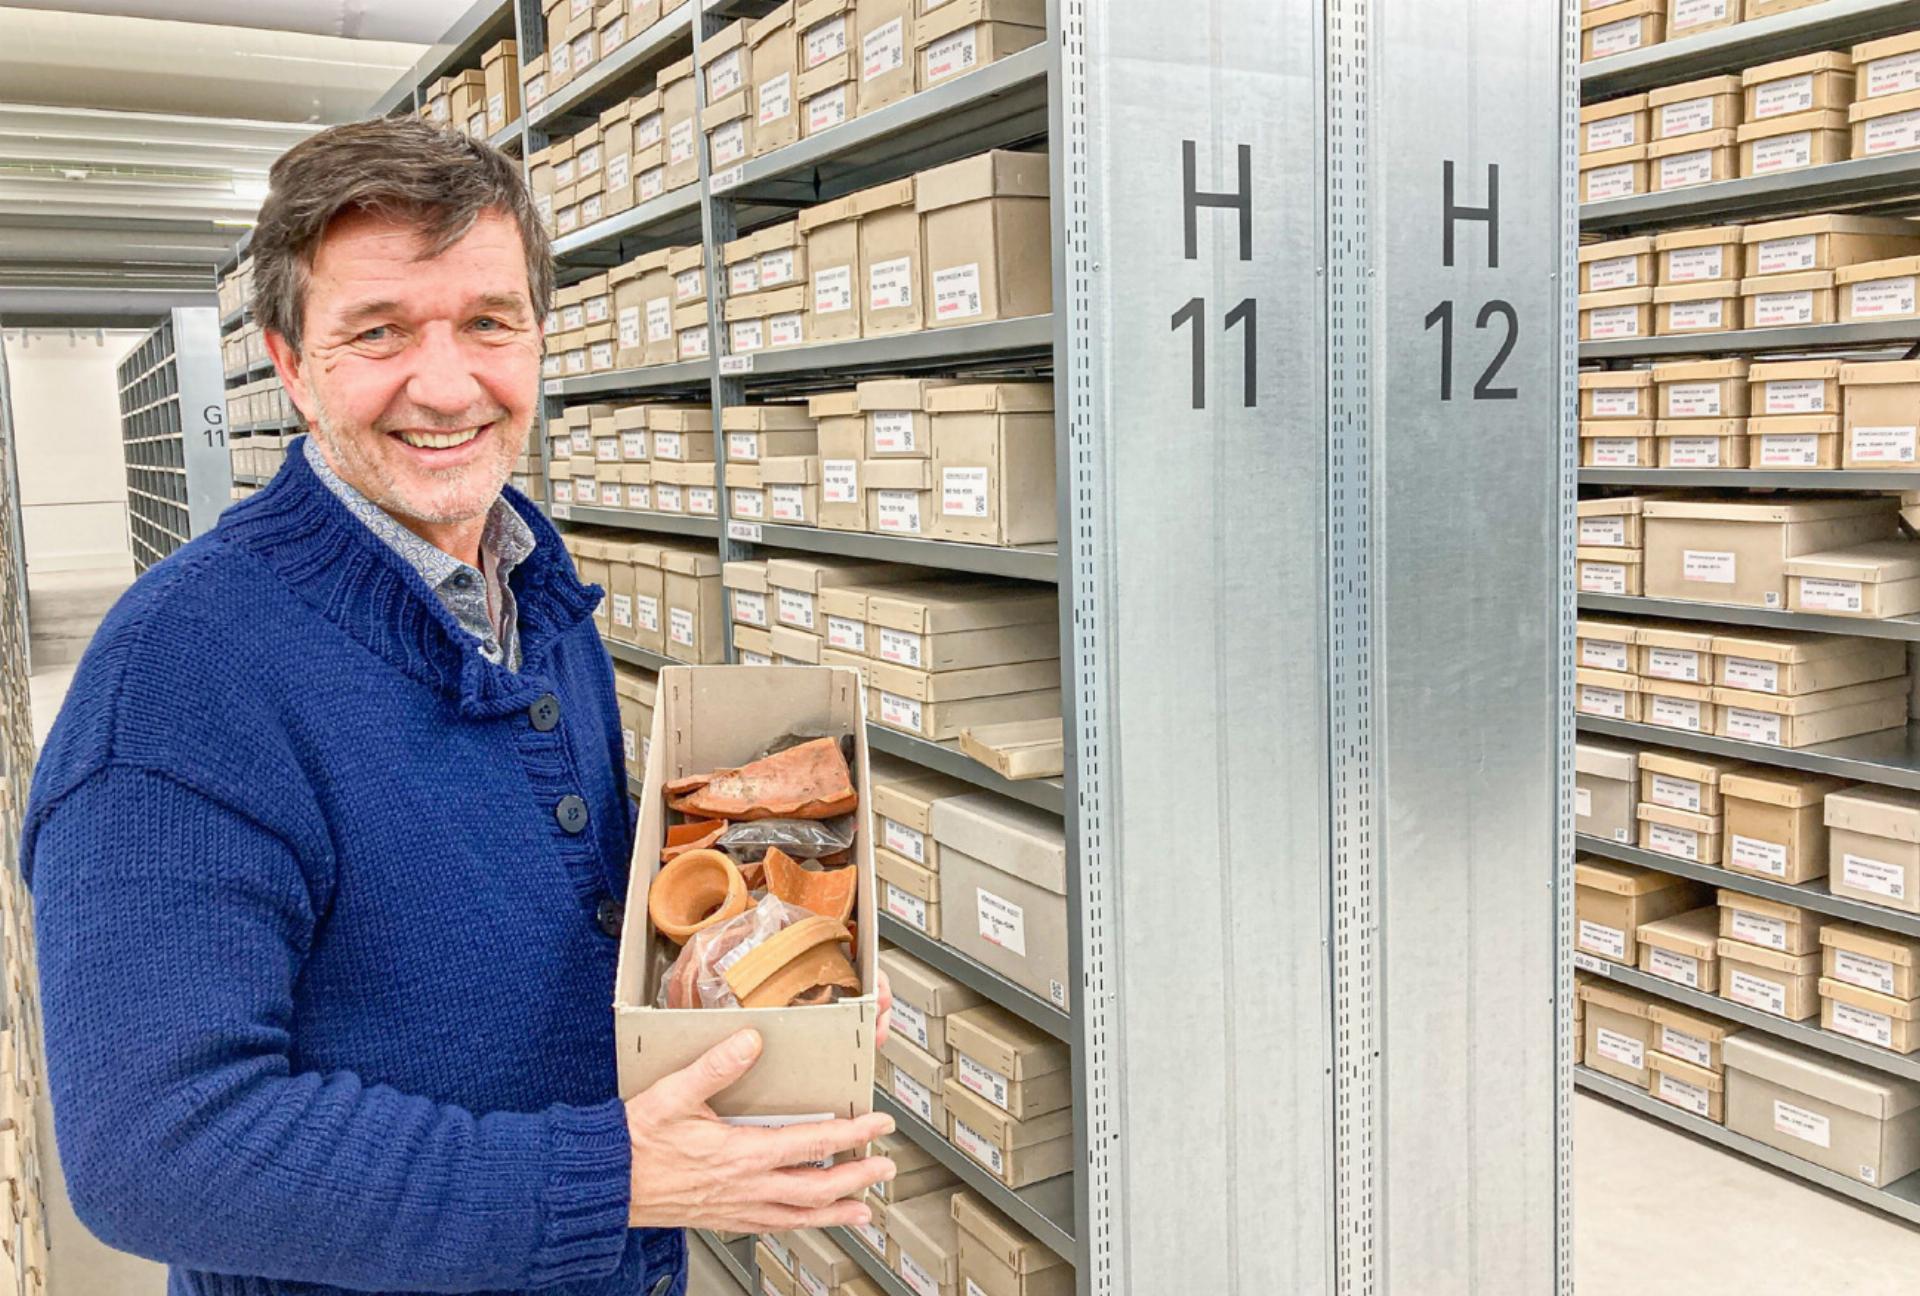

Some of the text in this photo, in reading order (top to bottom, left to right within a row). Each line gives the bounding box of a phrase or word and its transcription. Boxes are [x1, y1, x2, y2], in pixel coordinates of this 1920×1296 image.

[1182, 140, 1252, 261] H
[1443, 160, 1499, 268] H
[1171, 298, 1257, 410] 11
[1425, 299, 1519, 401] 12
[203, 405, 223, 425] G
[203, 429, 225, 448] 11
